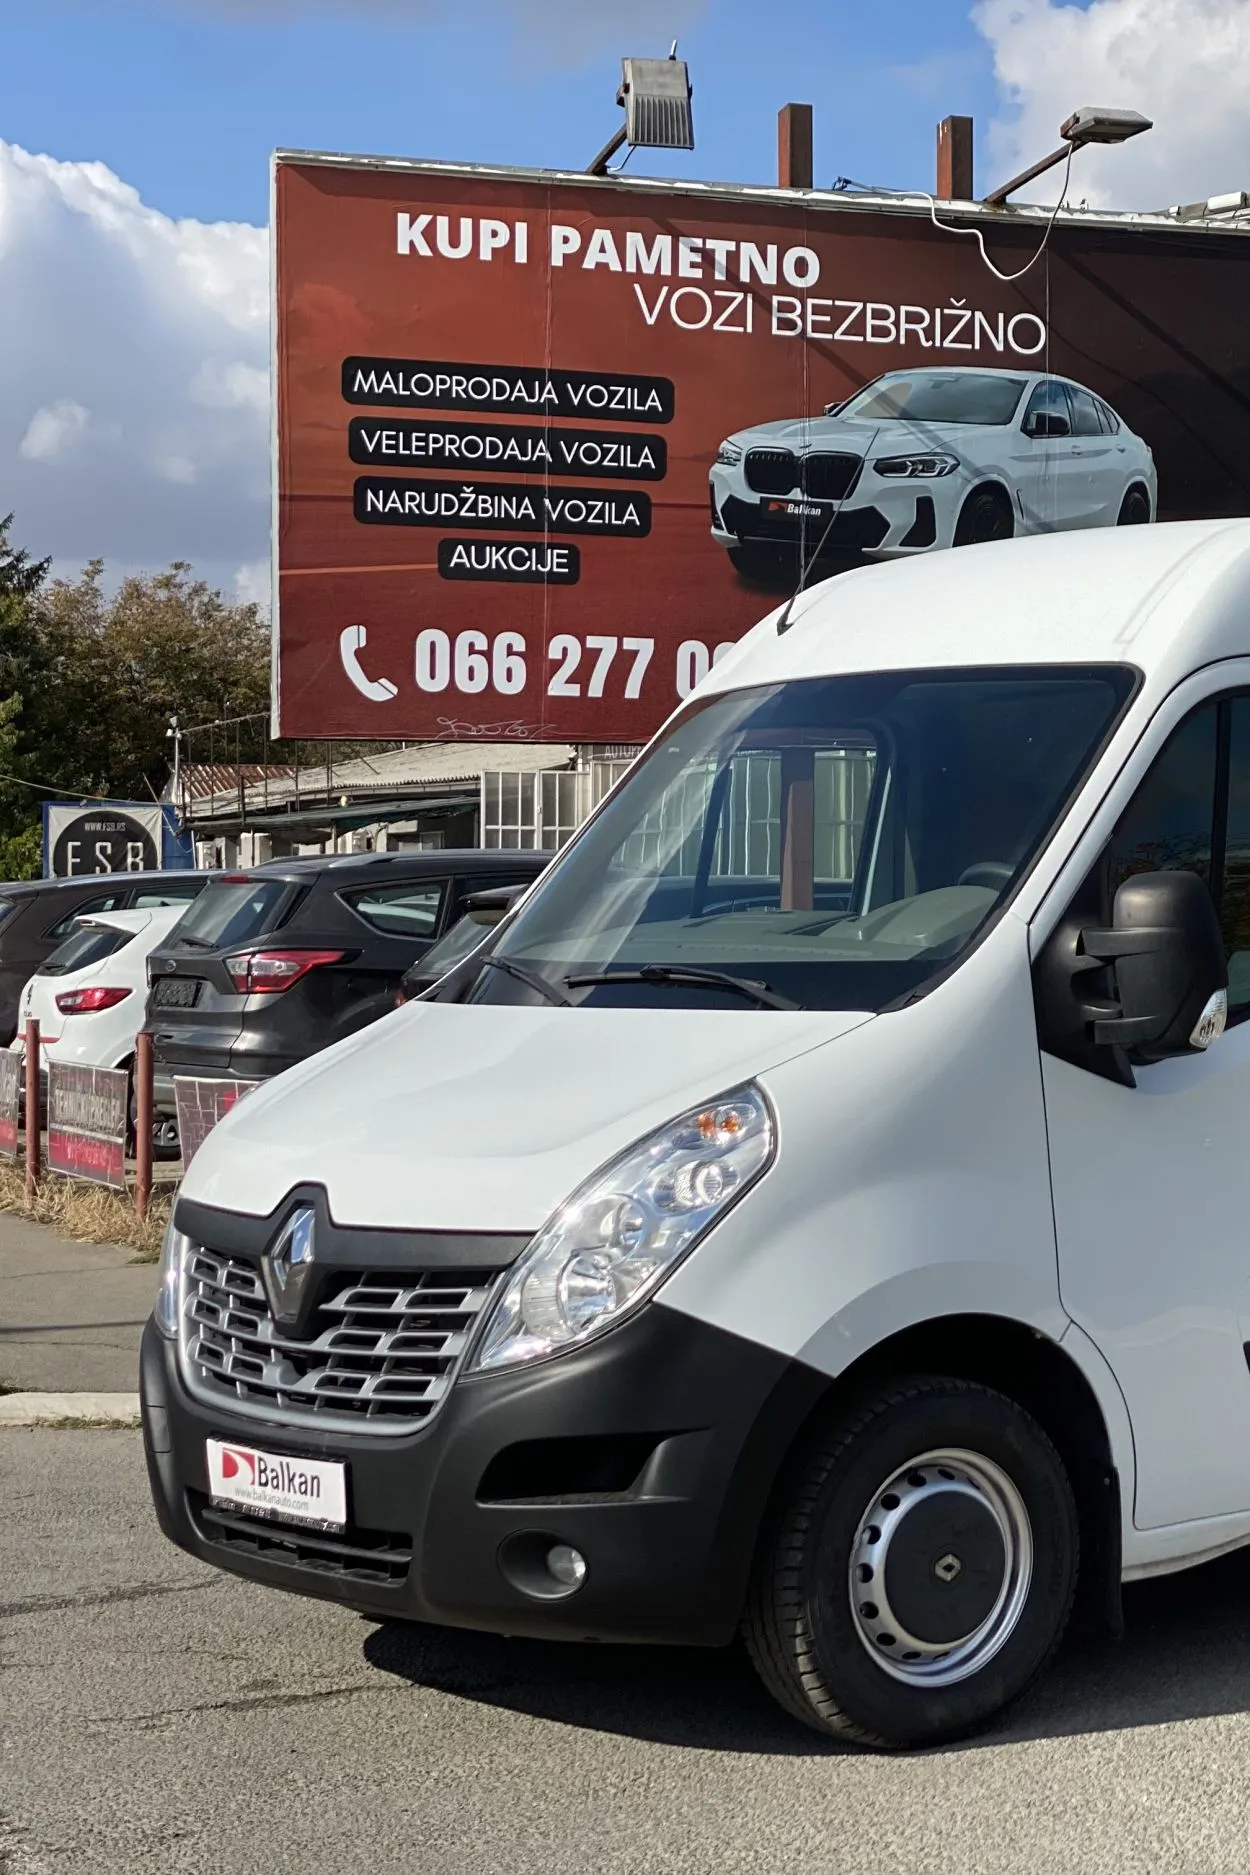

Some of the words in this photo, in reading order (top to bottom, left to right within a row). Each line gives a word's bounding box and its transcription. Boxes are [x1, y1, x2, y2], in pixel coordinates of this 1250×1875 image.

[396, 212, 529, 263] KUPI
[551, 224, 820, 288] PAMETNO
[633, 283, 753, 333] VOZI
[771, 296, 1047, 355] BEZBRIŽNO
[353, 368, 559, 404] MALOPRODAJA
[566, 382, 663, 412] VOZILA
[360, 428, 552, 462] VELEPRODAJA
[560, 440, 656, 469] VOZILA
[366, 486, 536, 520] NARUDŽBINA
[543, 497, 641, 526] VOZILA
[449, 544, 569, 573] AUKCIJE
[415, 627, 527, 695] 066
[547, 634, 655, 699] 277
[257, 1456, 321, 1498] Balkan
[234, 1486, 309, 1512] www.balkanauto.com
